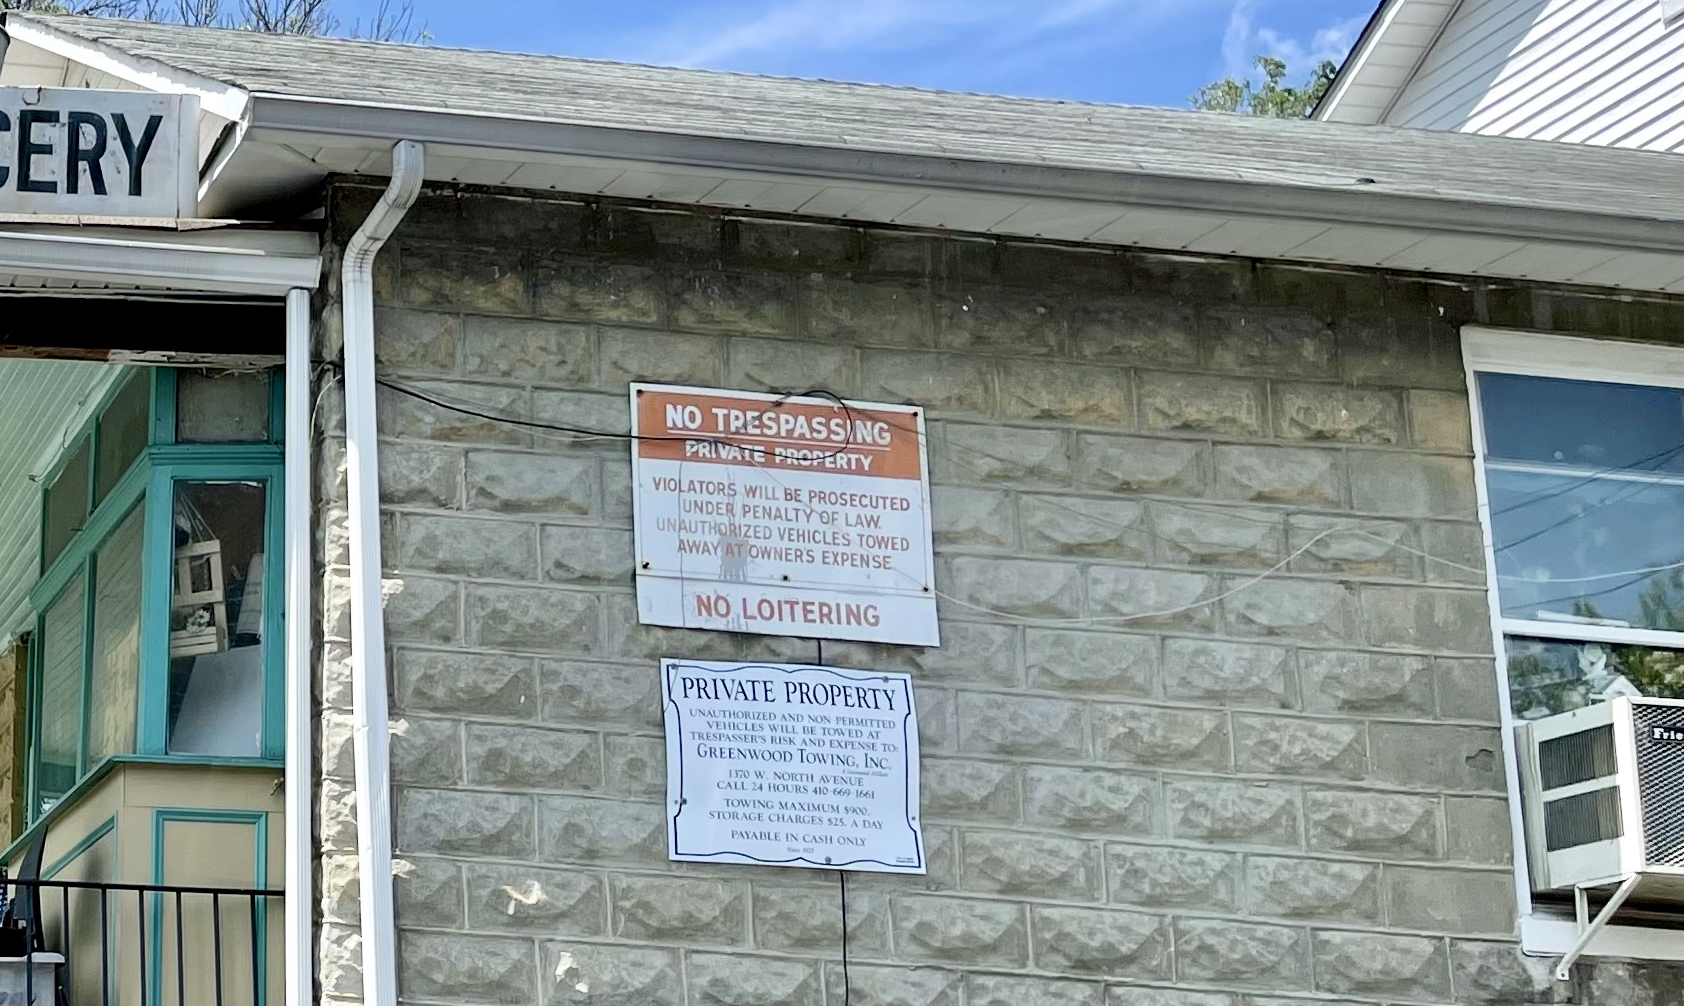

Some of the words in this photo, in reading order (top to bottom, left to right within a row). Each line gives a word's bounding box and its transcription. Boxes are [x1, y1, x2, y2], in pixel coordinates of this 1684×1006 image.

[666, 403, 703, 430] NO
[711, 407, 892, 446] TRESPASSING
[684, 439, 766, 463] PRIVATE
[774, 447, 874, 471] PROPERTY
[652, 476, 738, 497] VIOLATORS
[743, 484, 780, 502] WILL
[784, 487, 803, 503] BE
[808, 489, 911, 512] PROSECUTED
[682, 498, 736, 517] UNDER
[742, 504, 814, 524] PENALTY
[819, 510, 839, 525] OF
[844, 512, 882, 530] LAW.
[656, 516, 773, 541] UNAUTHORIZED
[777, 526, 852, 547] VEHICLES
[857, 533, 910, 552] TOWED
[677, 538, 721, 555] AWAY
[724, 542, 744, 559] AT
[748, 544, 816, 564] OWNER'S
[821, 550, 893, 571] EXPENSE
[695, 595, 731, 620] NO
[742, 597, 881, 628] LOITERING
[681, 676, 776, 704] PRIVATE
[784, 680, 897, 712] PROPERTY
[689, 708, 777, 722] UNAUTHORIZED
[779, 713, 805, 724] AND
[706, 720, 765, 732] VEHICLES
[768, 723, 798, 735] WILL
[802, 725, 817, 735] BE
[820, 726, 864, 738] TOWED
[867, 730, 882, 741] AT
[689, 731, 767, 744] TRESPASSER'S
[770, 735, 797, 746] RISK
[800, 737, 826, 748] AND
[829, 739, 878, 752] EXPENSE
[880, 742, 900, 754] TO:
[697, 742, 794, 763] GREENWOOD
[797, 748, 860, 769] TOWING,
[864, 752, 893, 771] INC.
[716, 779, 749, 792] CALL
[751, 781, 764, 793] 24
[768, 782, 809, 795] HOURS
[812, 786, 876, 800] 410-669-1661
[728, 768, 751, 780] 1370
[754, 770, 770, 781] W.
[773, 771, 814, 783] NORTH
[818, 774, 865, 787] AVENUE
[708, 810, 765, 823] STORAGE
[768, 813, 824, 826] CHARGES
[851, 818, 860, 829] A
[862, 819, 884, 830] DAY
[724, 798, 775, 810] TOWING
[778, 800, 841, 814] MAXIMUM
[731, 829, 782, 842] PAYABLE
[785, 832, 799, 843] IN
[802, 834, 834, 845] CASH
[837, 835, 868, 847] ONLY
